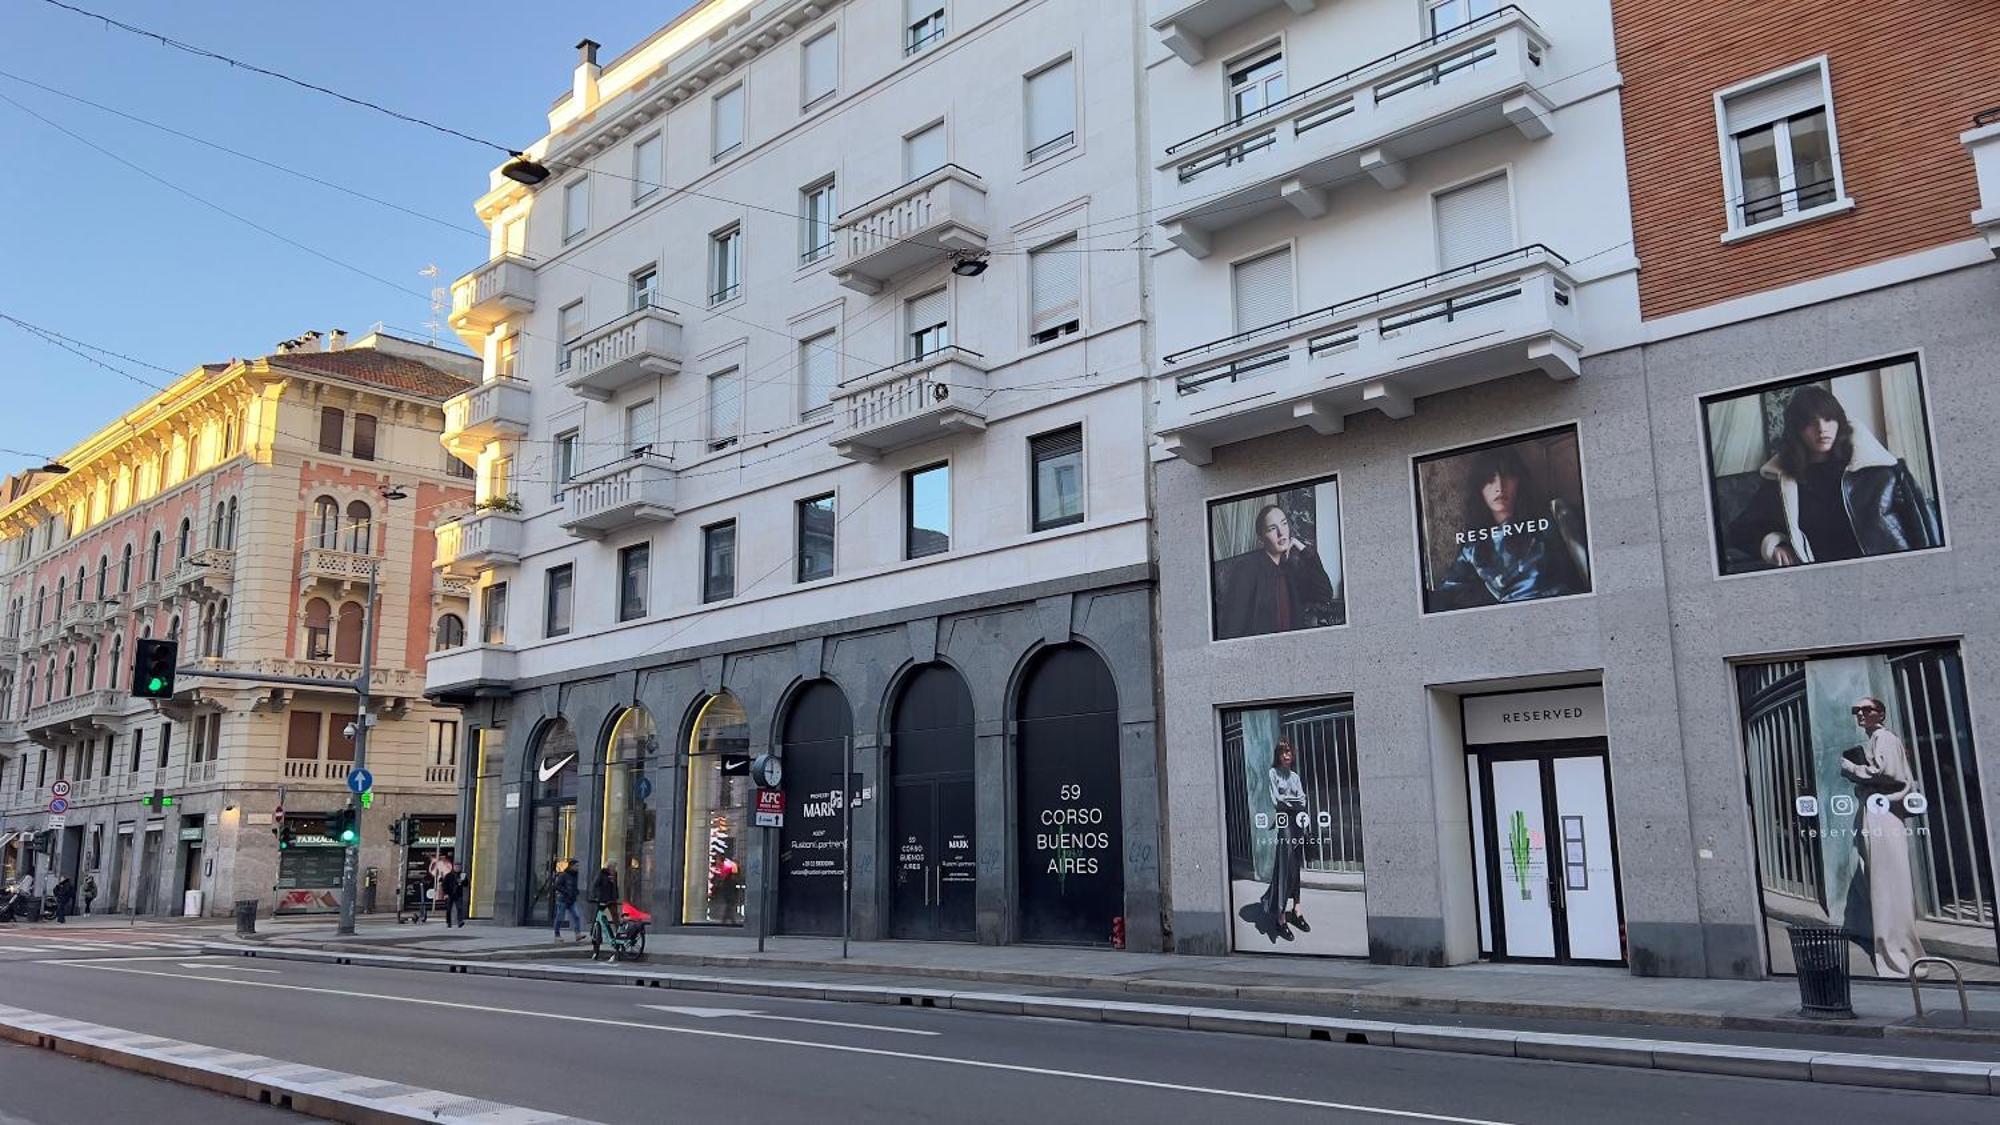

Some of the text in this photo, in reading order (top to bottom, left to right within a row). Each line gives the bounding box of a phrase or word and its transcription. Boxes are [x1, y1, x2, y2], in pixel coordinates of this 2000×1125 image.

[1455, 519, 1549, 544] RESERVED
[1503, 708, 1583, 723] RESERVED
[55, 785, 66, 793] 30
[1061, 785, 1081, 800] 59
[761, 791, 781, 804] KFC
[803, 802, 836, 818] MARK
[1041, 808, 1103, 825] CORSO
[297, 835, 338, 844] FARMA
[1801, 826, 1931, 838] reservedcom
[1037, 833, 1109, 849] BUENOS
[1047, 858, 1098, 874] AIRES
